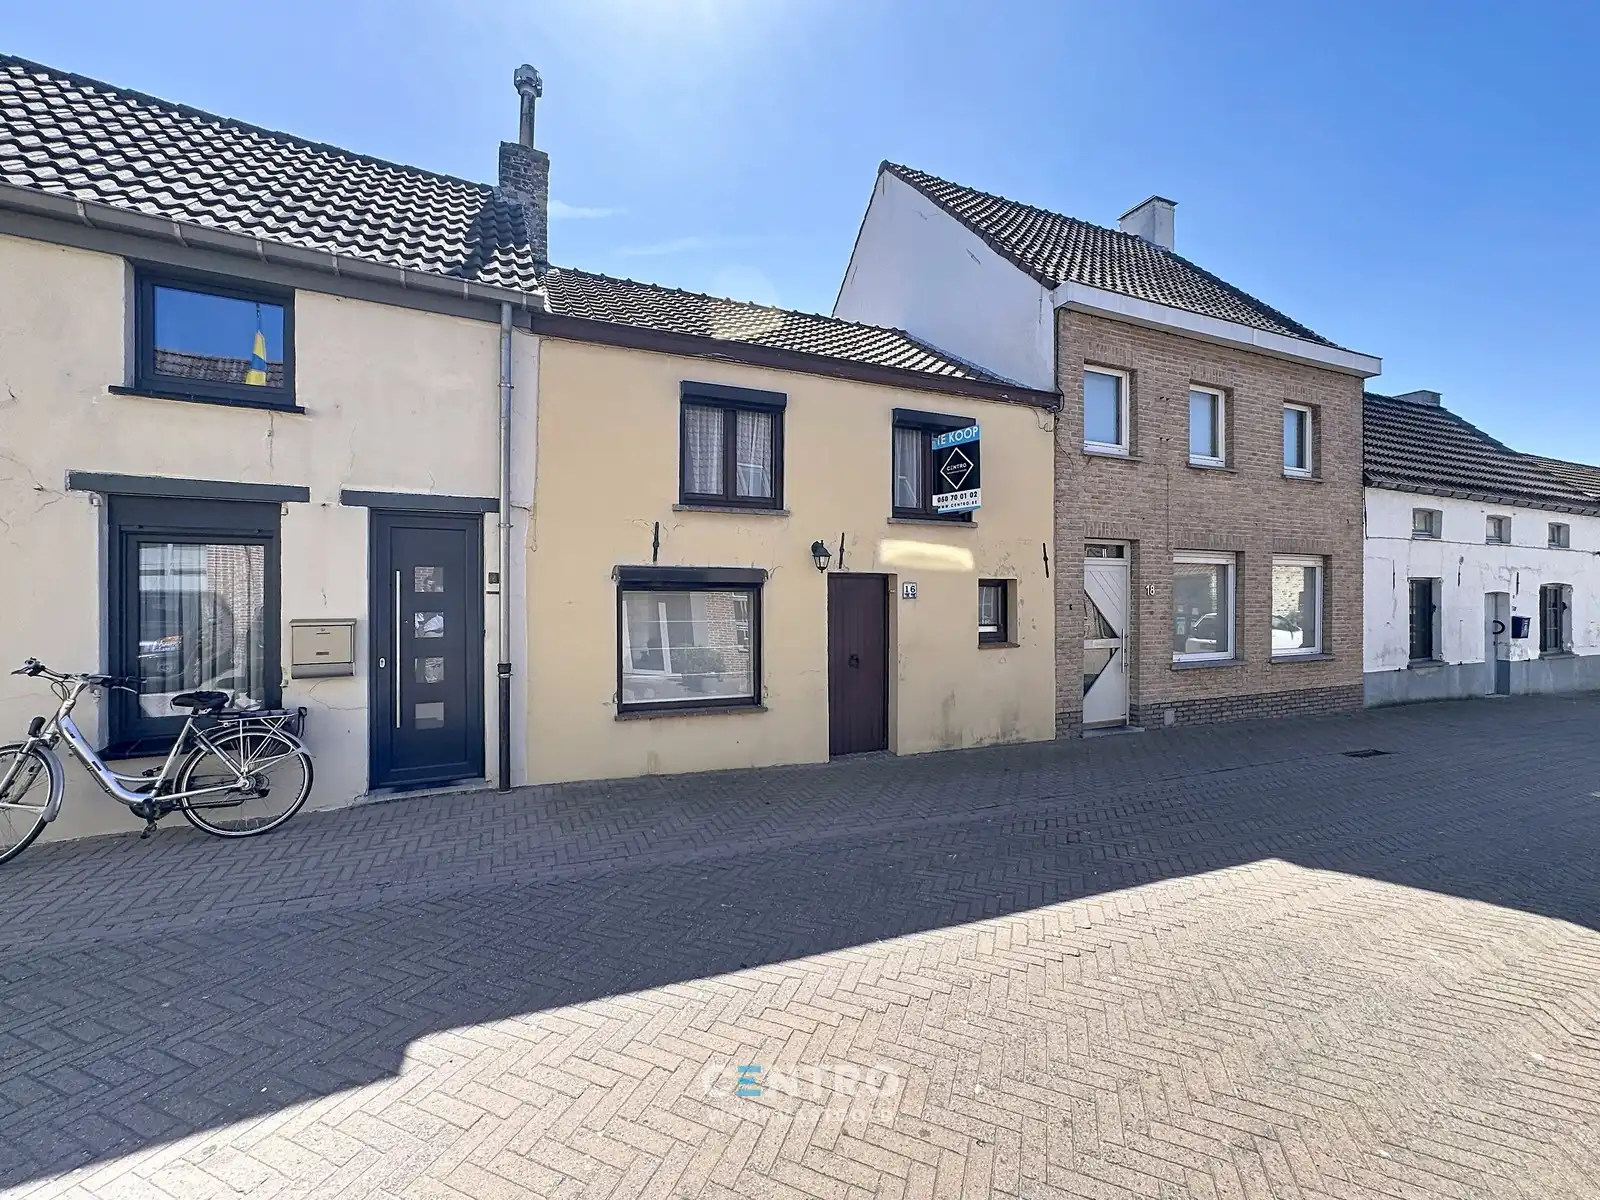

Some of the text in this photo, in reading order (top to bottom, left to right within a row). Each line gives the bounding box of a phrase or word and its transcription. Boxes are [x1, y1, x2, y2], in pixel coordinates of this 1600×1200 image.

[949, 426, 979, 443] KOOP
[946, 462, 967, 471] CENTRO
[937, 495, 949, 503] 050
[960, 492, 967, 500] 01
[969, 490, 978, 499] 02
[905, 585, 916, 593] 16
[1145, 584, 1155, 596] 18
